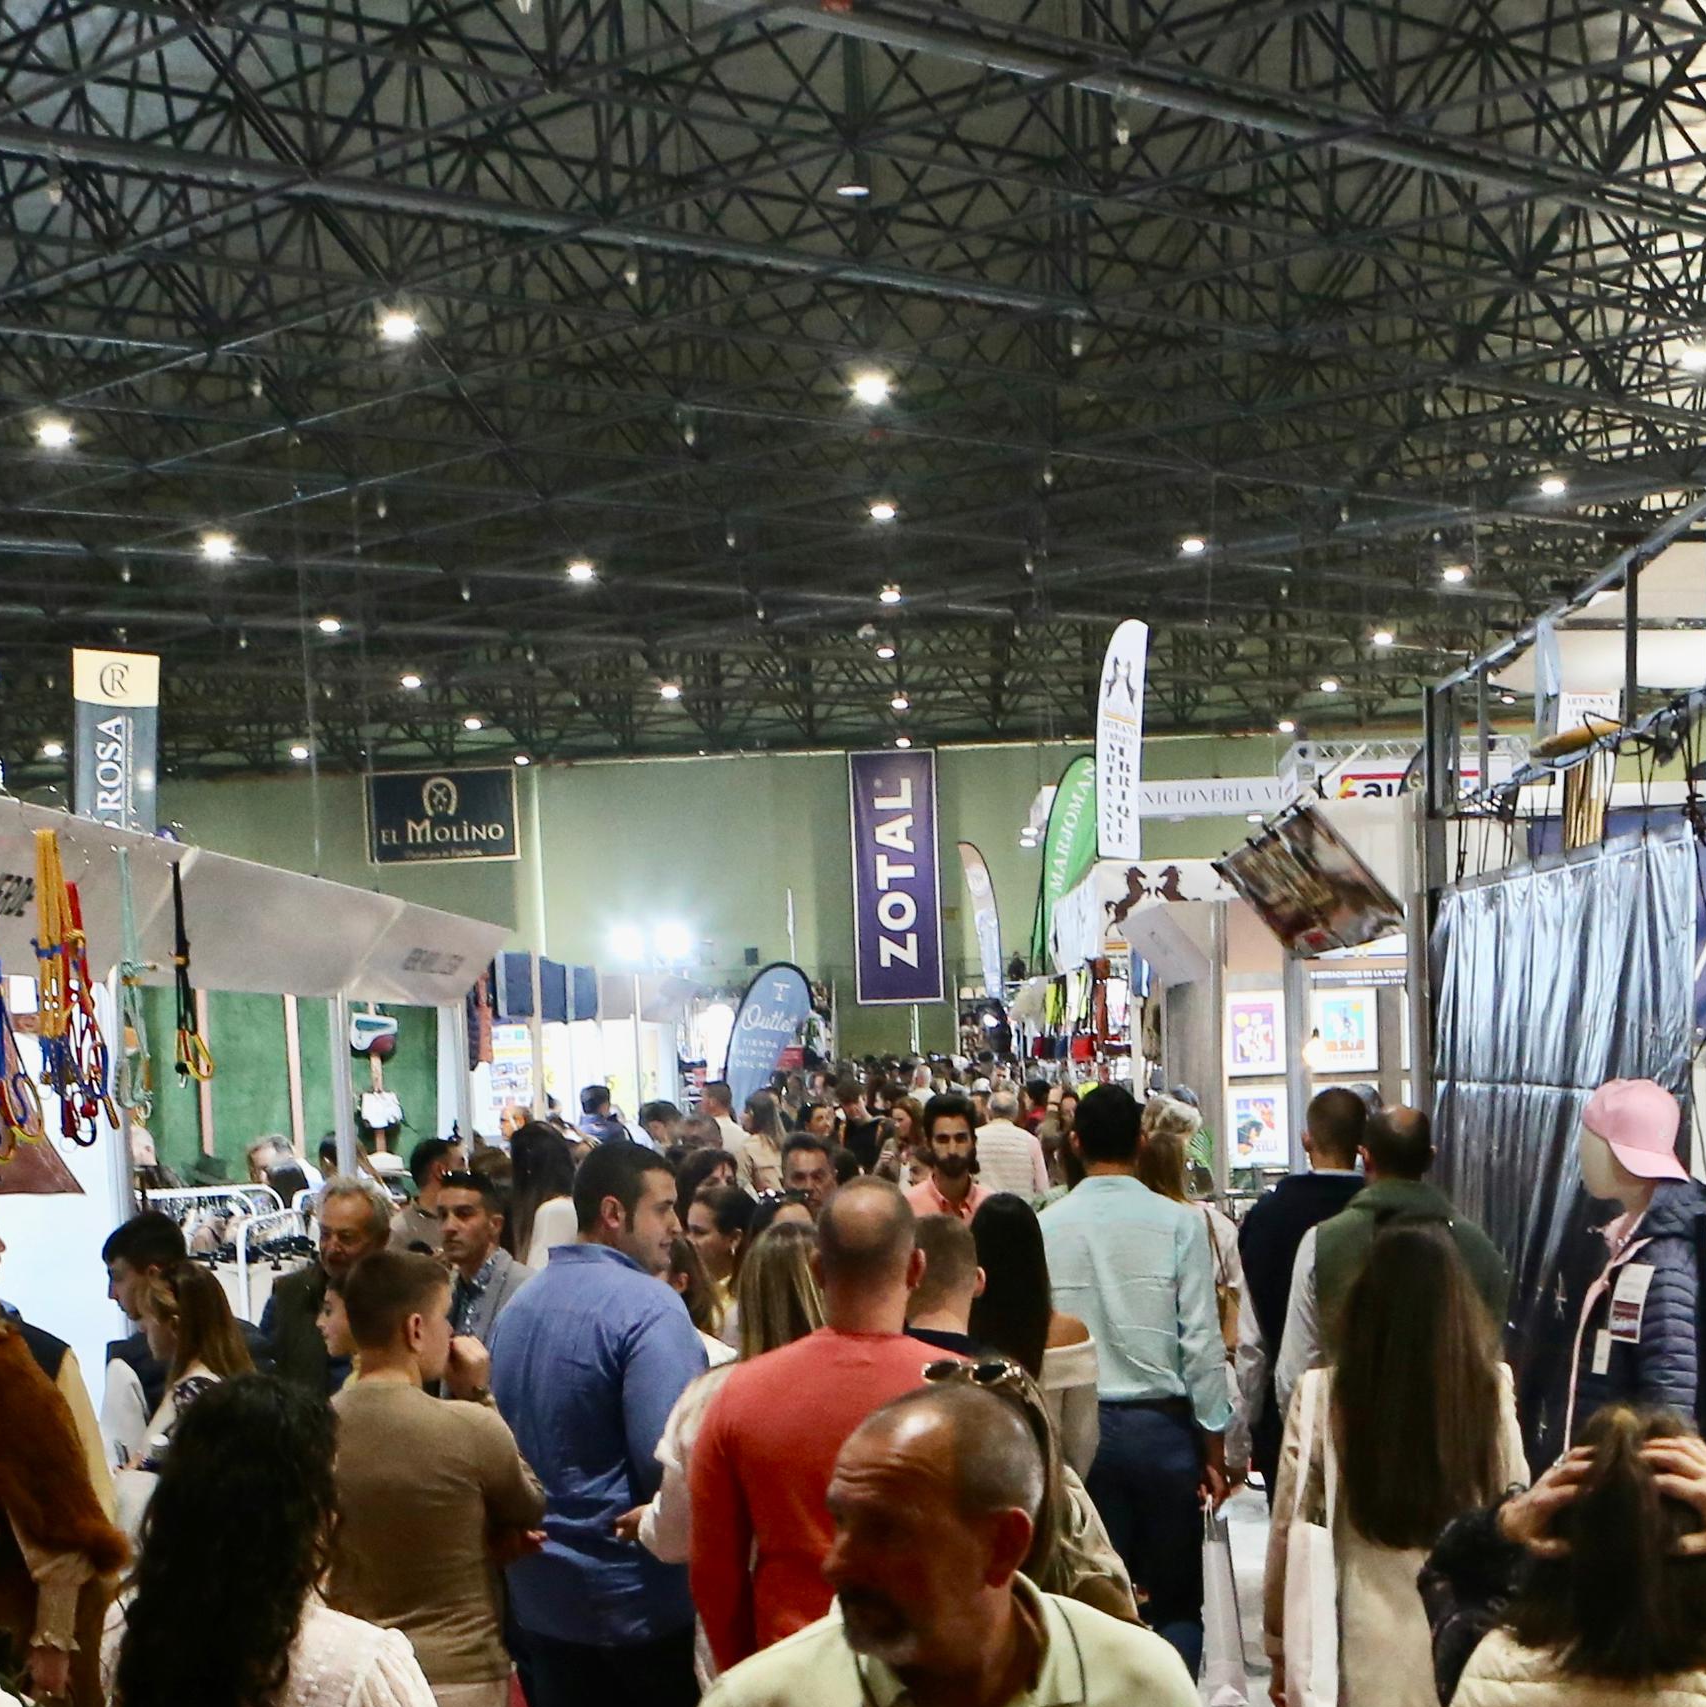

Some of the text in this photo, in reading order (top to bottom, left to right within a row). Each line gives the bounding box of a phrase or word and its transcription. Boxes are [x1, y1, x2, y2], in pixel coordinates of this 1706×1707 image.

[96, 716, 125, 811] ROSA
[1050, 761, 1096, 892] MARJOMAN
[874, 777, 919, 968] ZOTAL
